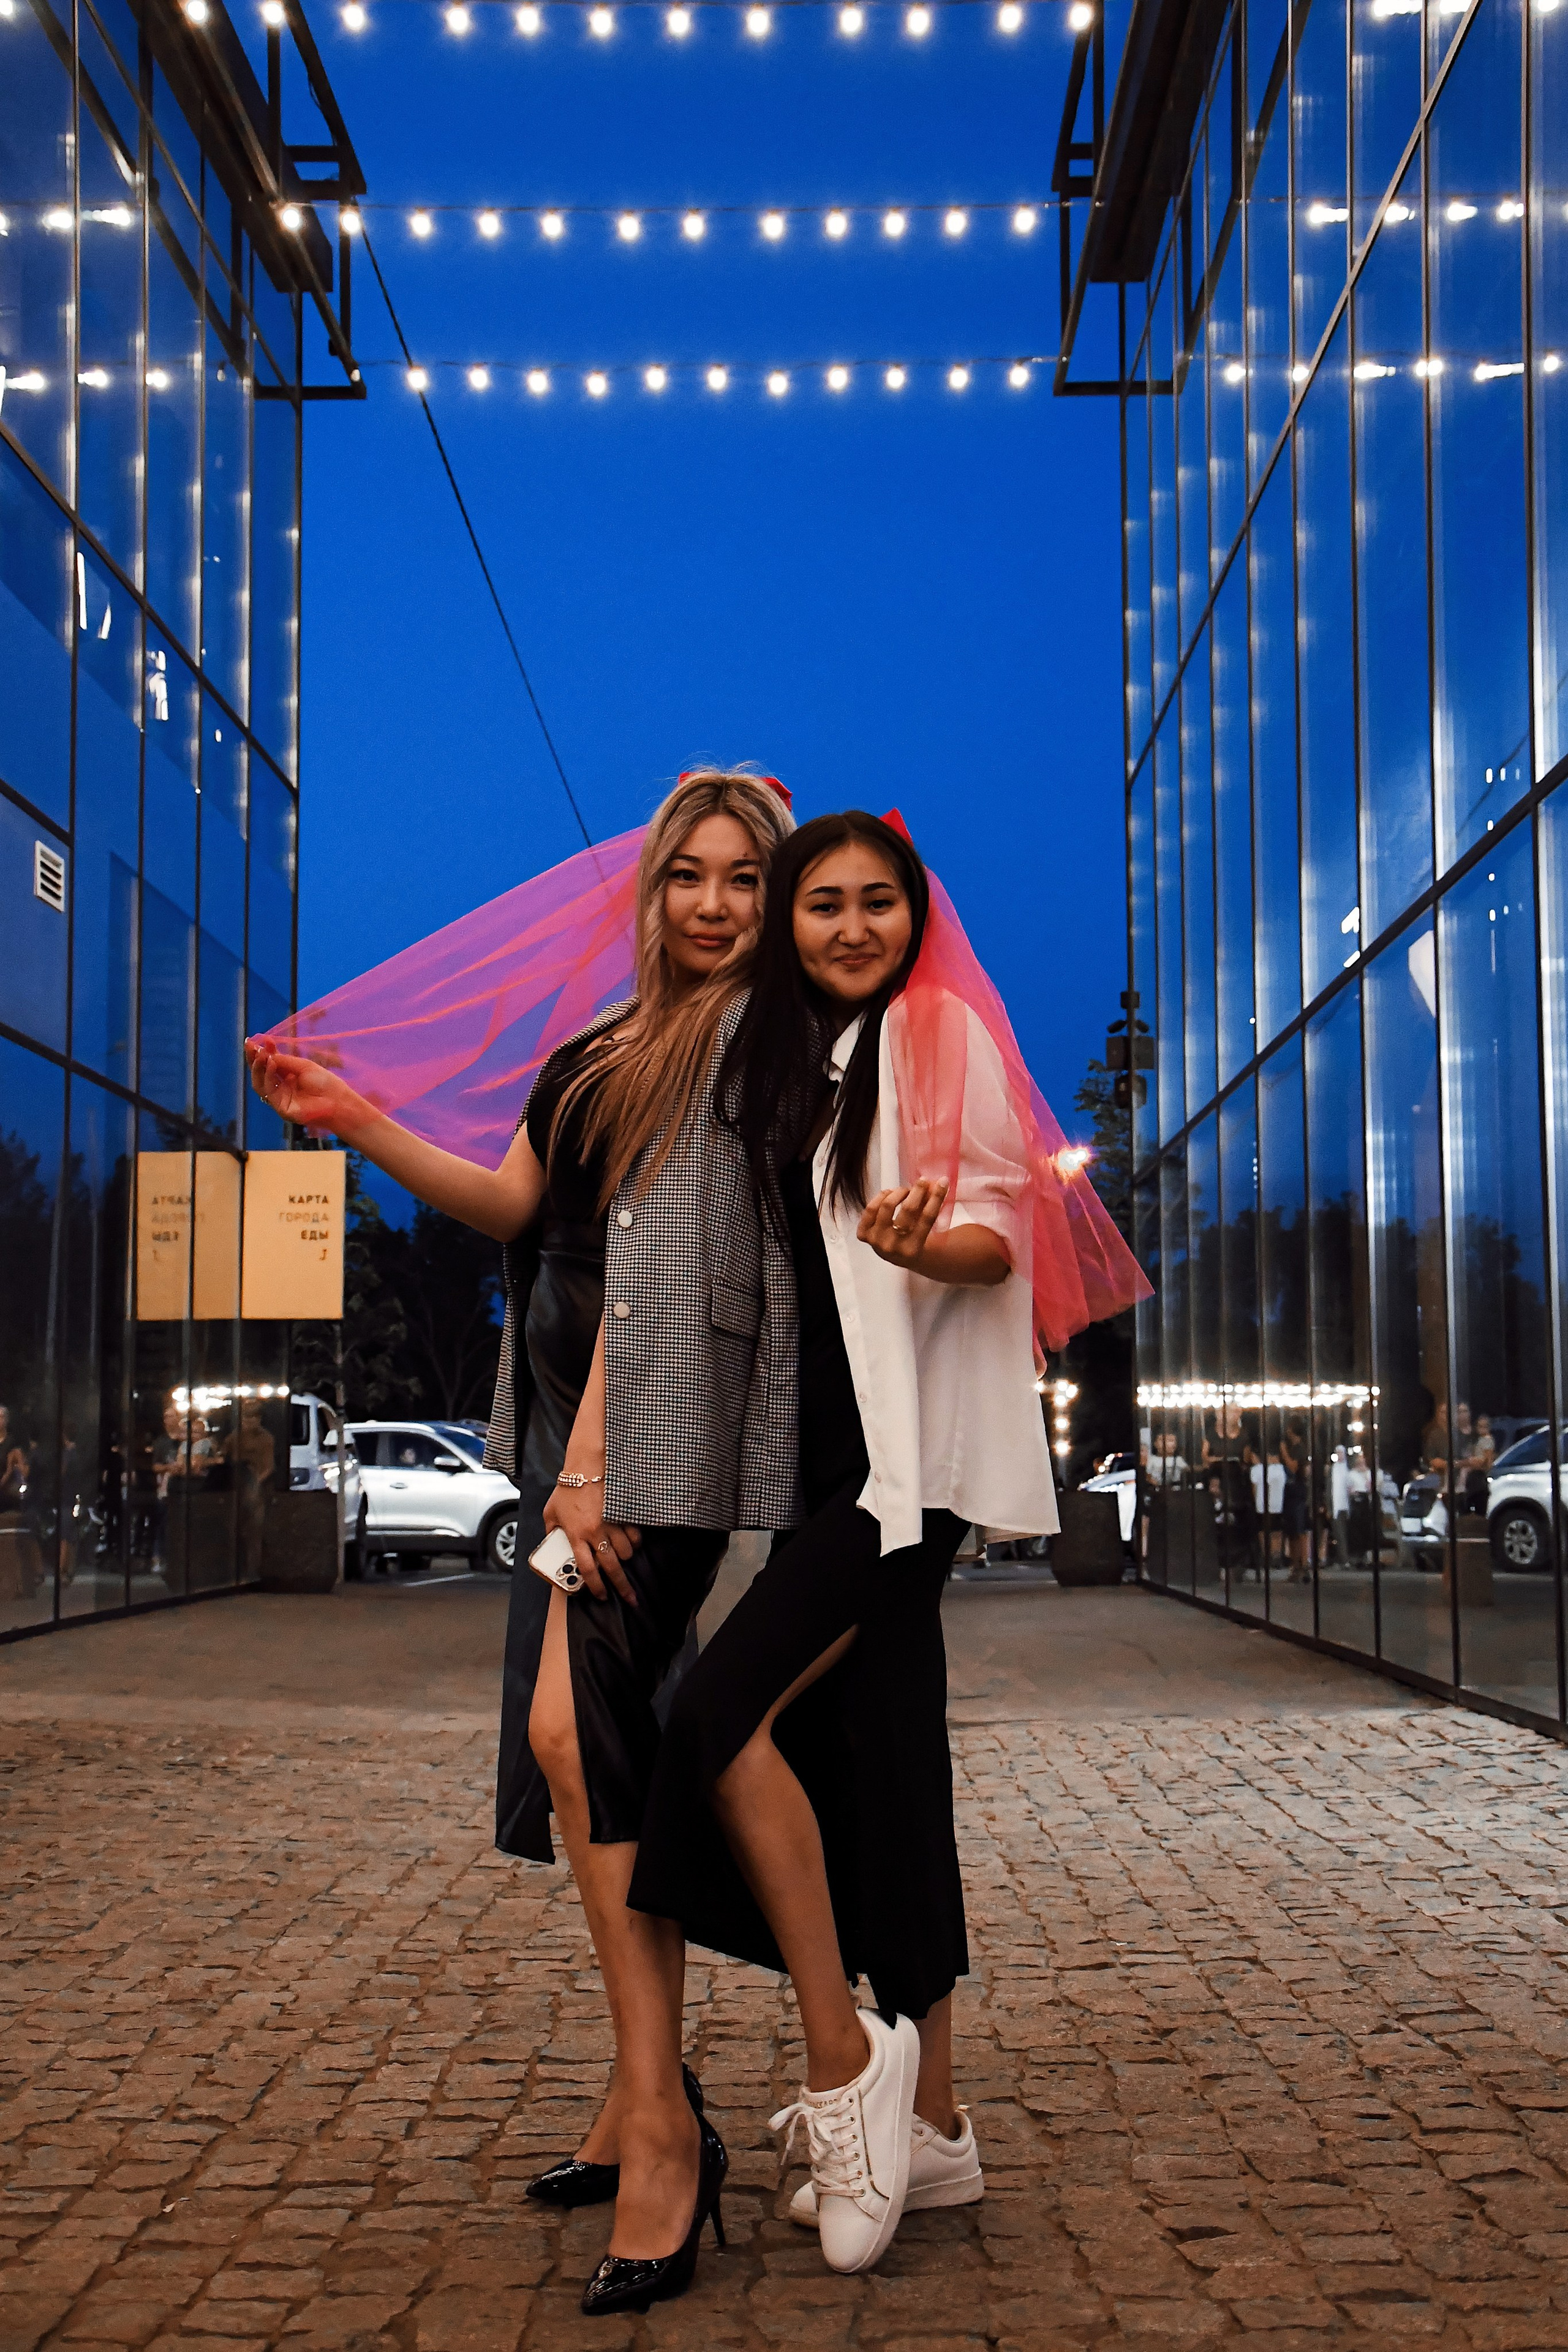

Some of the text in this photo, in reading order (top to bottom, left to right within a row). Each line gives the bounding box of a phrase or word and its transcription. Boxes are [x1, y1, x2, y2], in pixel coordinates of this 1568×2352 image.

[288, 1195, 329, 1204] КАРТА
[279, 1212, 329, 1223] ГОРОДА
[301, 1230, 329, 1241] ЕДЫ
